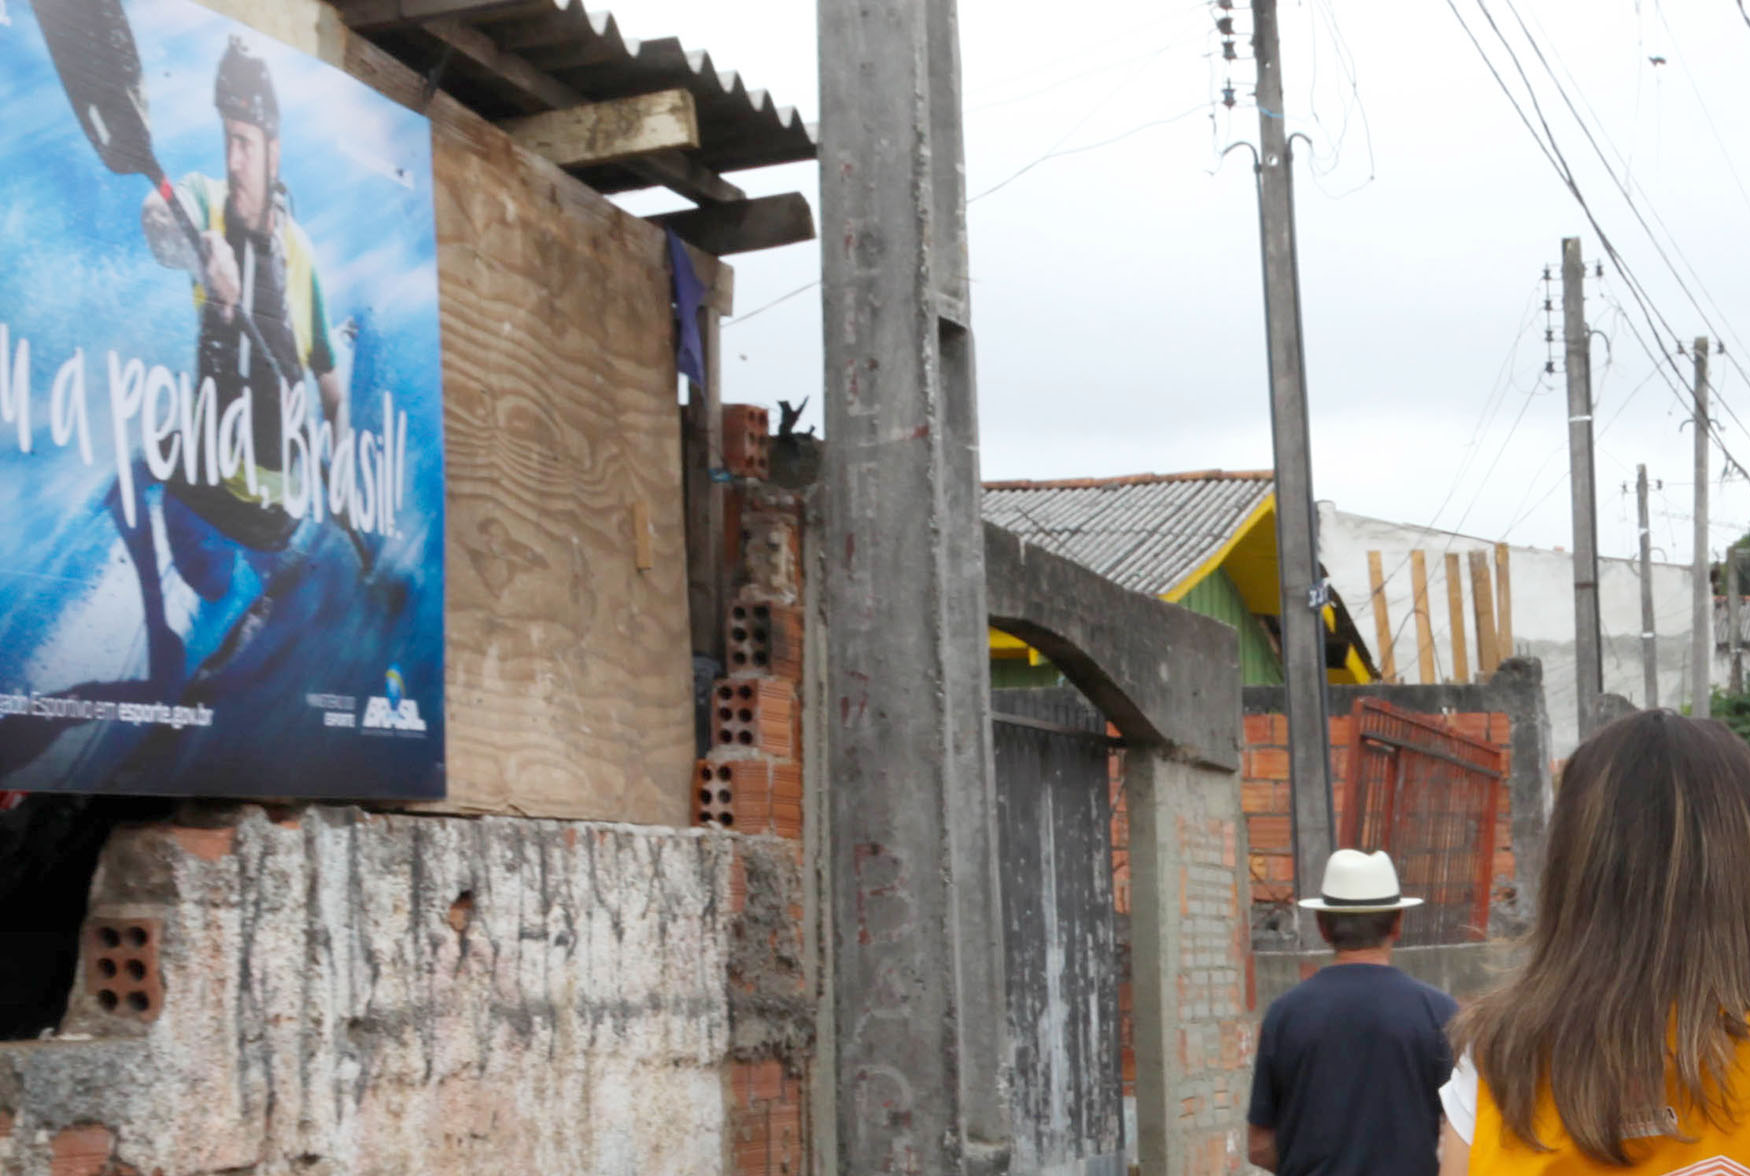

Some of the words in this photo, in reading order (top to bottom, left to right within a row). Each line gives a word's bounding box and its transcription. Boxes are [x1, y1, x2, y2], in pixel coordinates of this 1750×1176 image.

[51, 346, 93, 467] a
[107, 349, 270, 528] pena,
[279, 374, 408, 540] Brasil!
